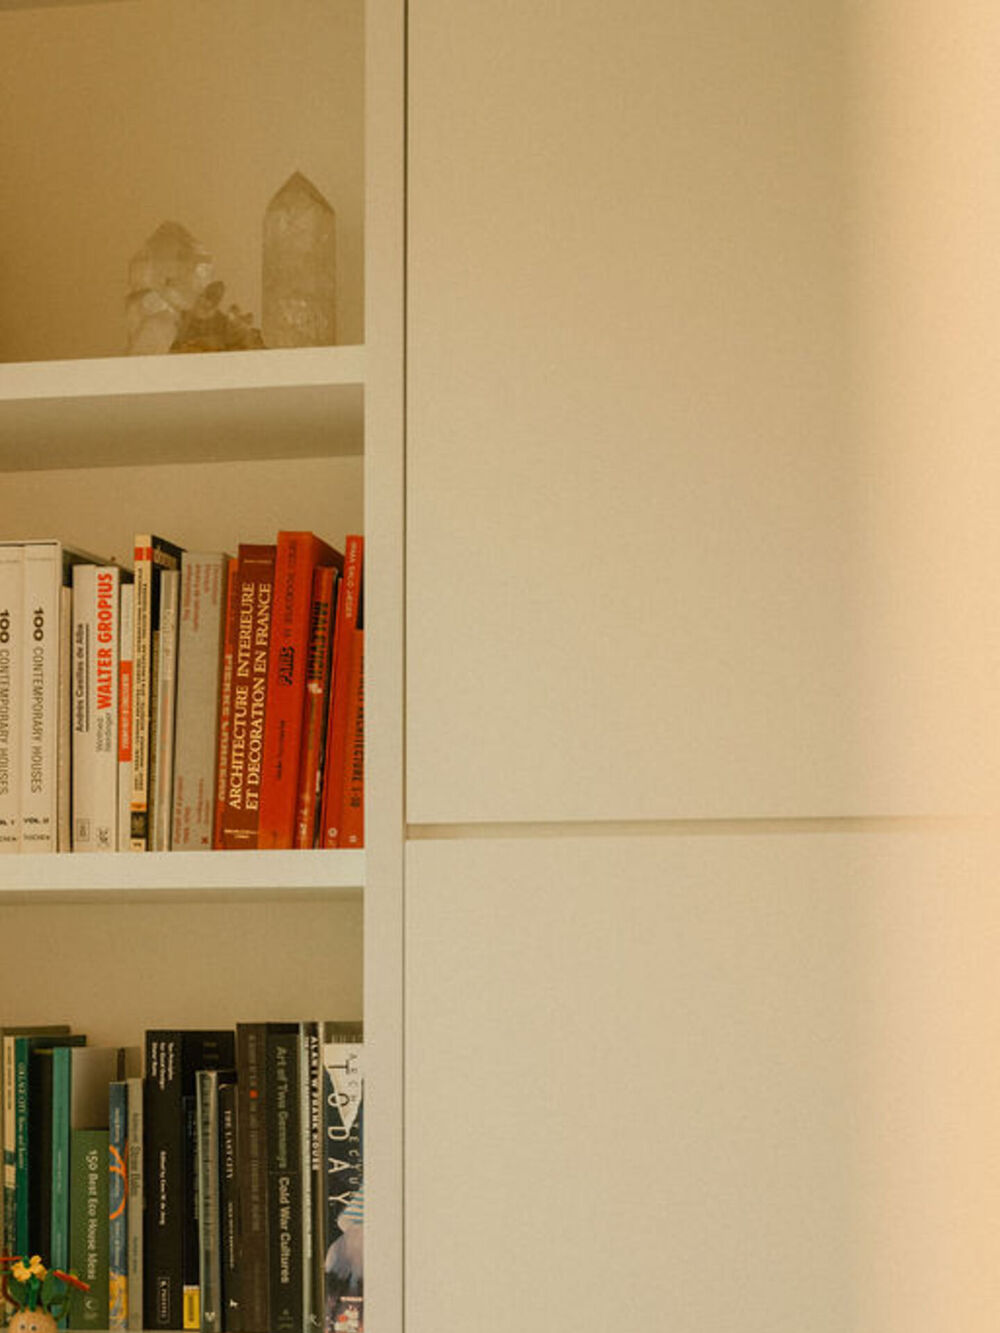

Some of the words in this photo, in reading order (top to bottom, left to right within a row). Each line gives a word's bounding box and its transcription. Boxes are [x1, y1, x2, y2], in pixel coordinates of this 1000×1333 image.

[32, 607, 45, 642] 100
[97, 573, 113, 643] GROPIUS
[256, 583, 271, 646] FRANCE
[236, 582, 256, 676] INTERIEURE
[254, 650, 268, 672] EN
[97, 648, 112, 709] WALTER
[31, 647, 45, 744] CONTEMPORARY
[247, 677, 266, 784] DECORATION
[229, 685, 248, 810] ARCHITECTURE
[30, 747, 43, 793] HOUSES
[246, 788, 258, 810] ET
[276, 1046, 288, 1066] Art
[276, 1068, 288, 1080] of
[277, 1084, 288, 1108] Two
[327, 1059, 351, 1204] TODAY
[85, 1149, 98, 1170] 150
[311, 1134, 320, 1170] HOUSE
[87, 1172, 98, 1195] Best
[279, 1176, 291, 1205] Cold
[87, 1197, 98, 1216] Eco
[279, 1207, 291, 1231] War
[86, 1218, 98, 1250] House
[86, 1252, 98, 1280] Ideas
[280, 1232, 291, 1283] Cultures
